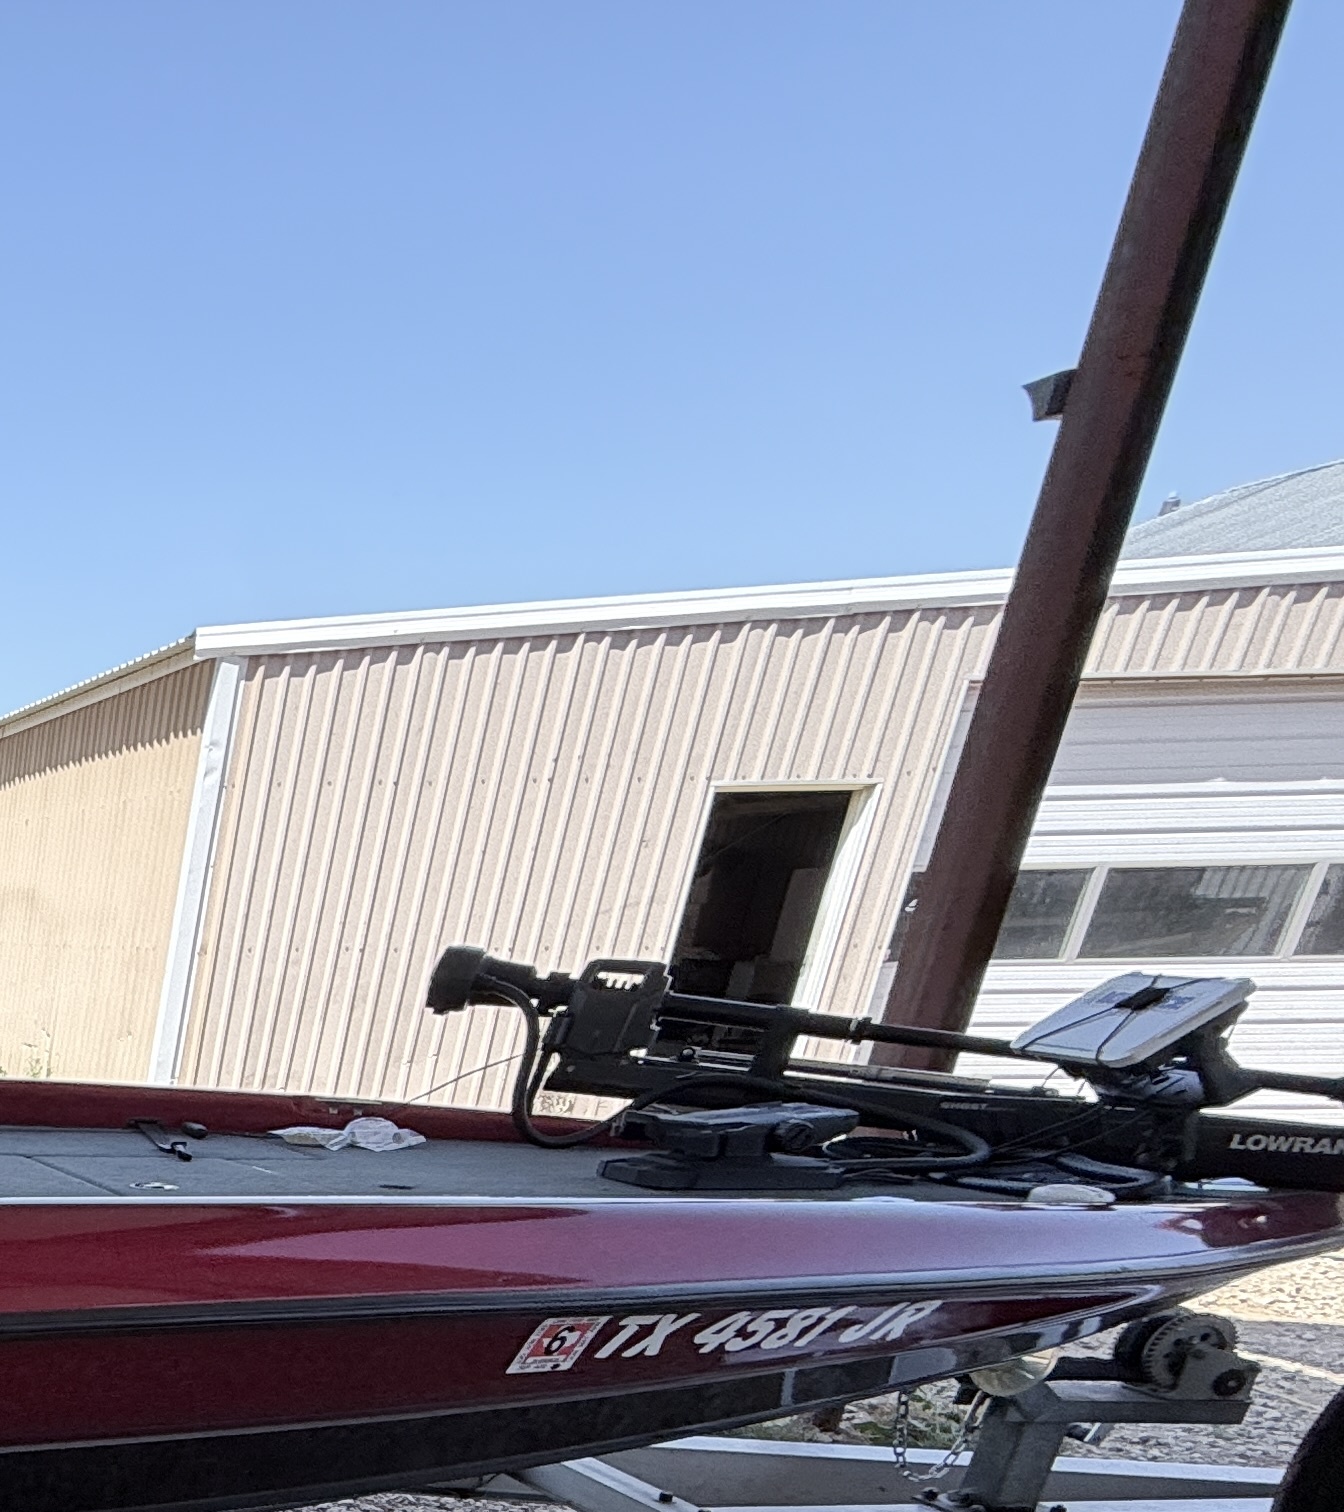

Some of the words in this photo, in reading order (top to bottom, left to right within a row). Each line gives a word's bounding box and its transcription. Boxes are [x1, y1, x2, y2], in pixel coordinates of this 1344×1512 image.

[543, 1326, 576, 1355] 6
[594, 1313, 702, 1359] TX
[694, 1305, 858, 1354] 4581
[838, 1300, 943, 1343] JR
